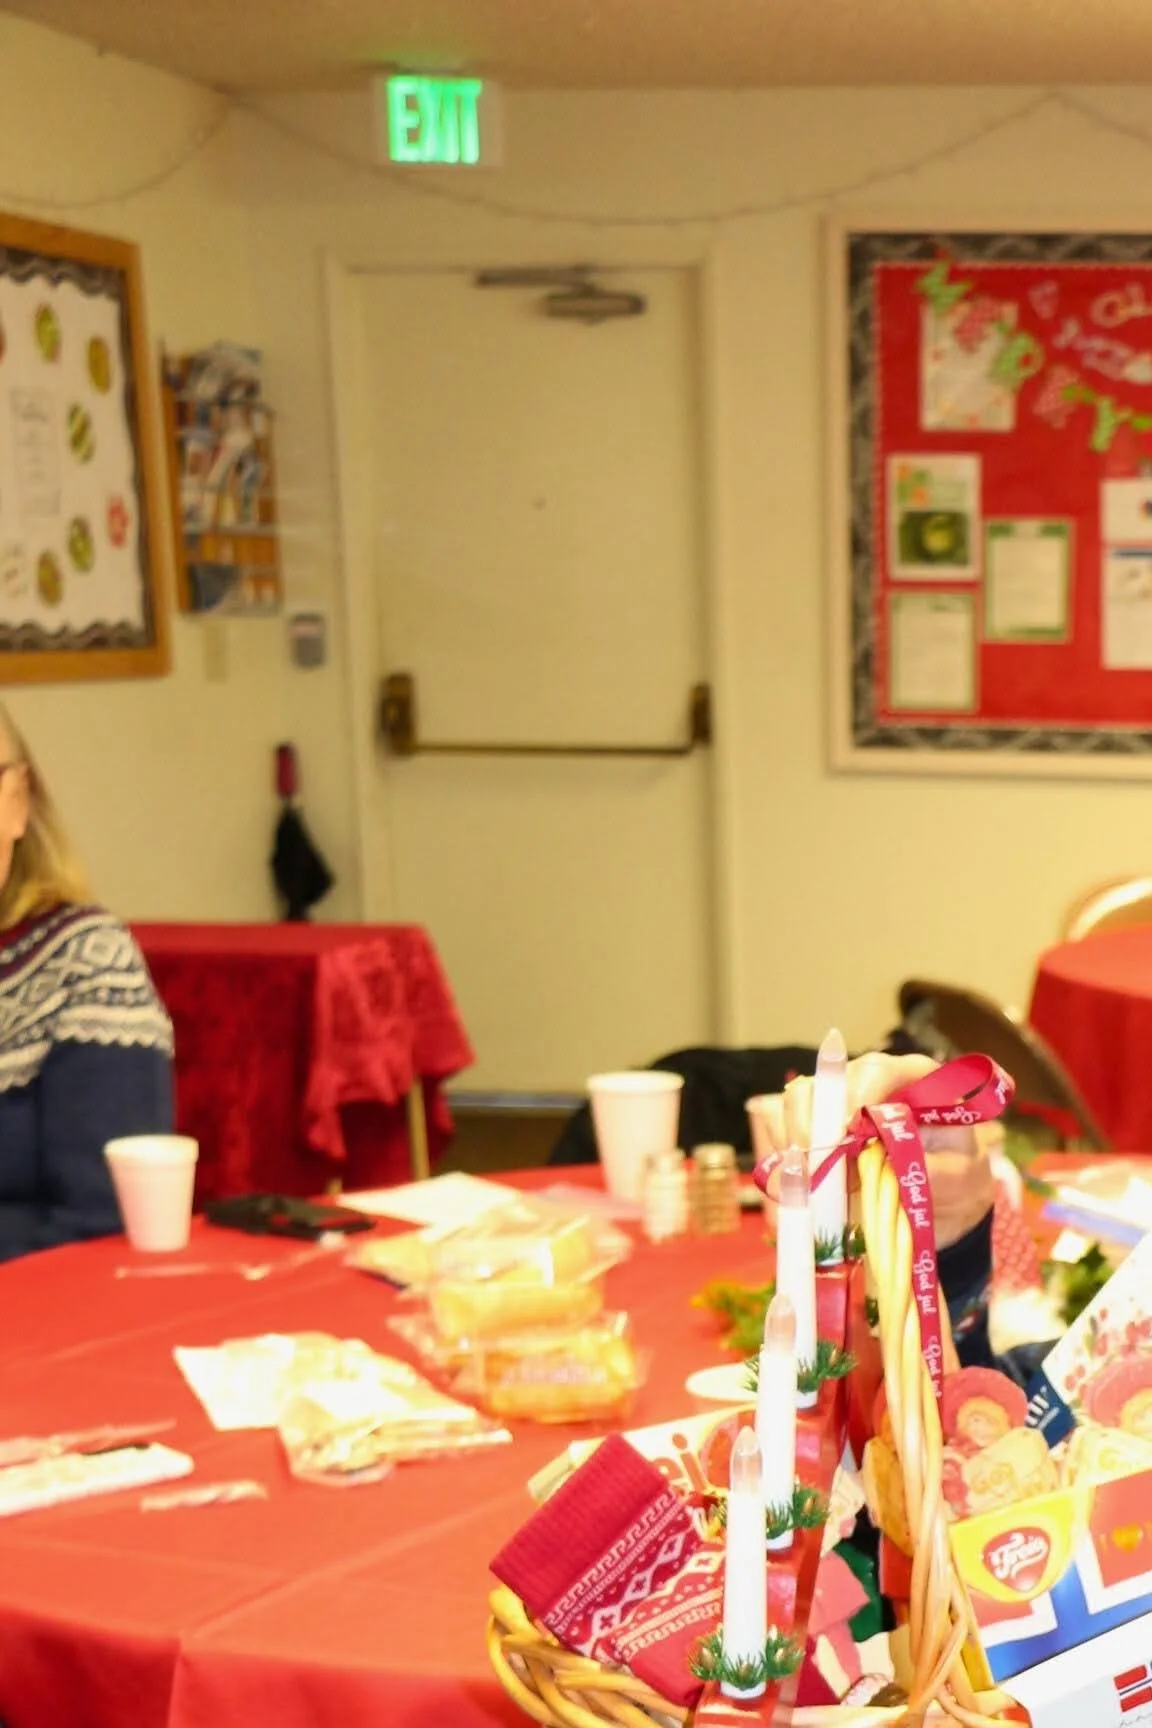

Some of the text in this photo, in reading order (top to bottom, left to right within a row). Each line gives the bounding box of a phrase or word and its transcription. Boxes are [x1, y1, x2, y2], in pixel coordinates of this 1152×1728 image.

[386, 75, 482, 164] EXIT
[900, 1161, 931, 1229] God jul
[913, 1249, 937, 1316] God jul
[923, 1335, 942, 1376] God
